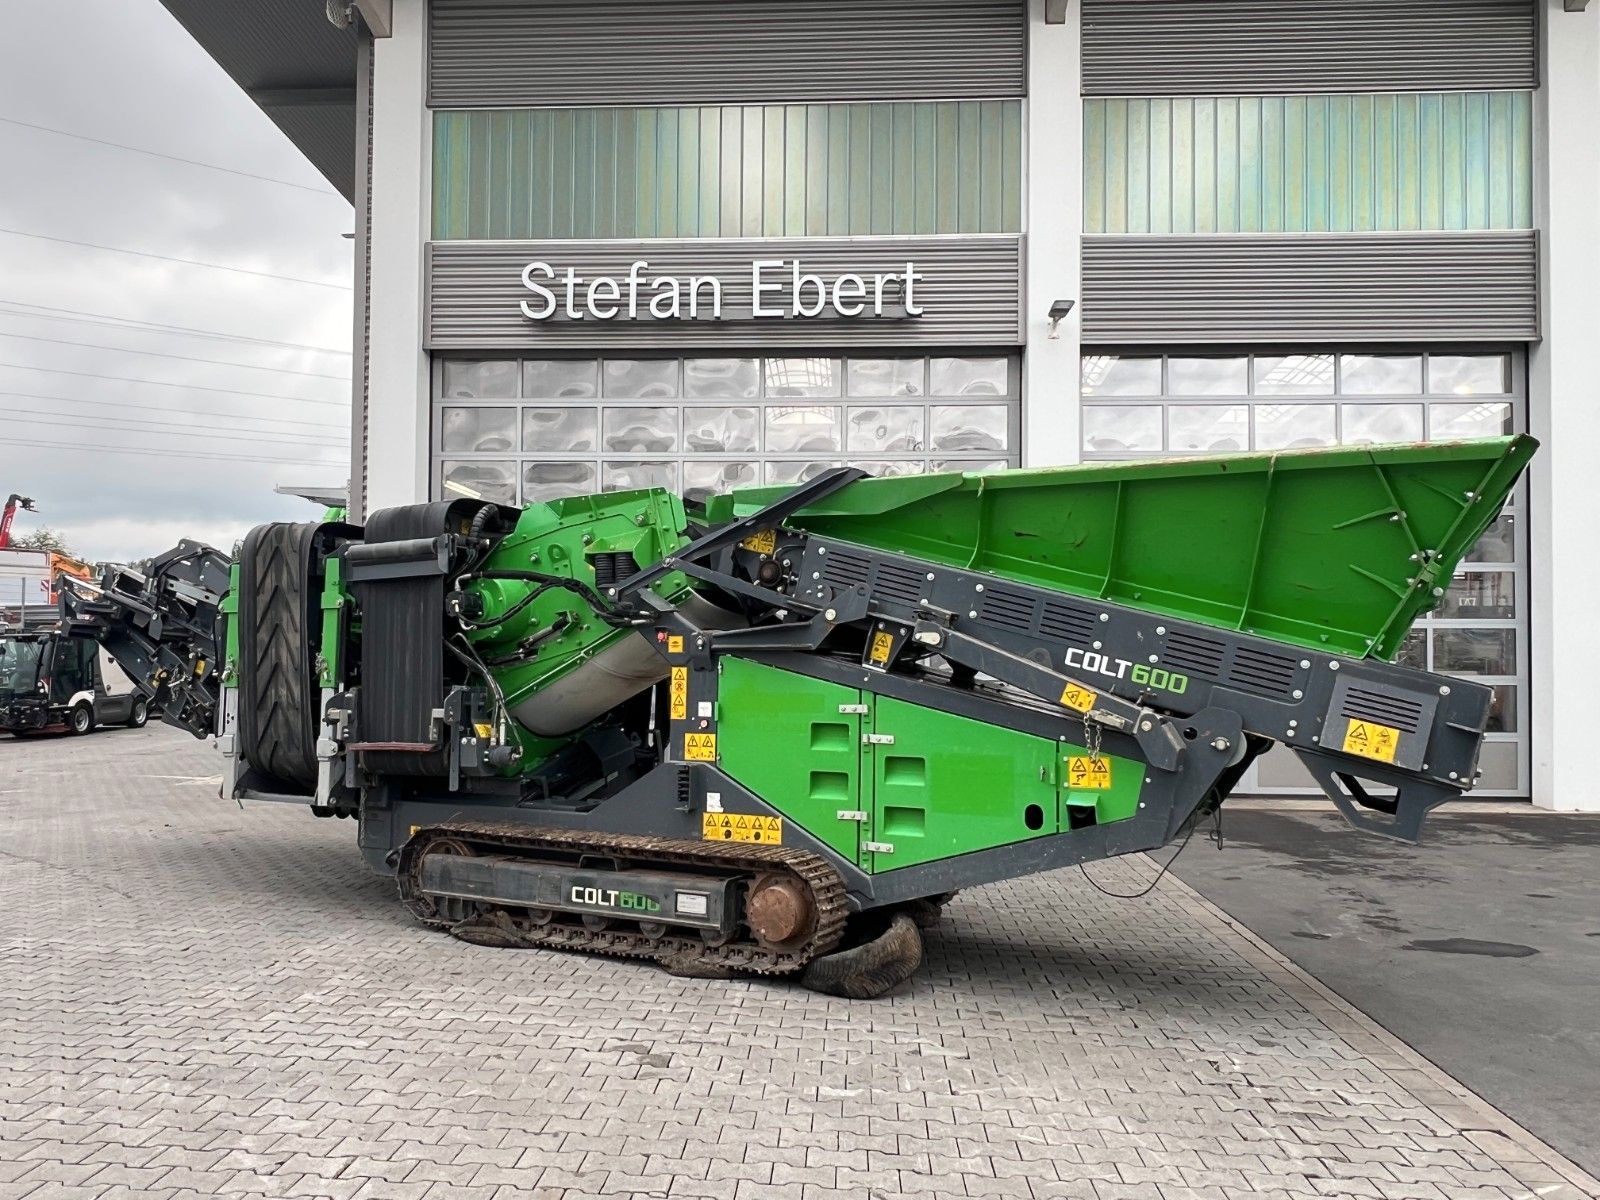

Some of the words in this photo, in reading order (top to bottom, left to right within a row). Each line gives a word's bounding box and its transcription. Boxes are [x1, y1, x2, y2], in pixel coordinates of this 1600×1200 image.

[519, 260, 722, 319] Stefan
[751, 259, 925, 317] Ebert
[1063, 646, 1189, 695] COLT600
